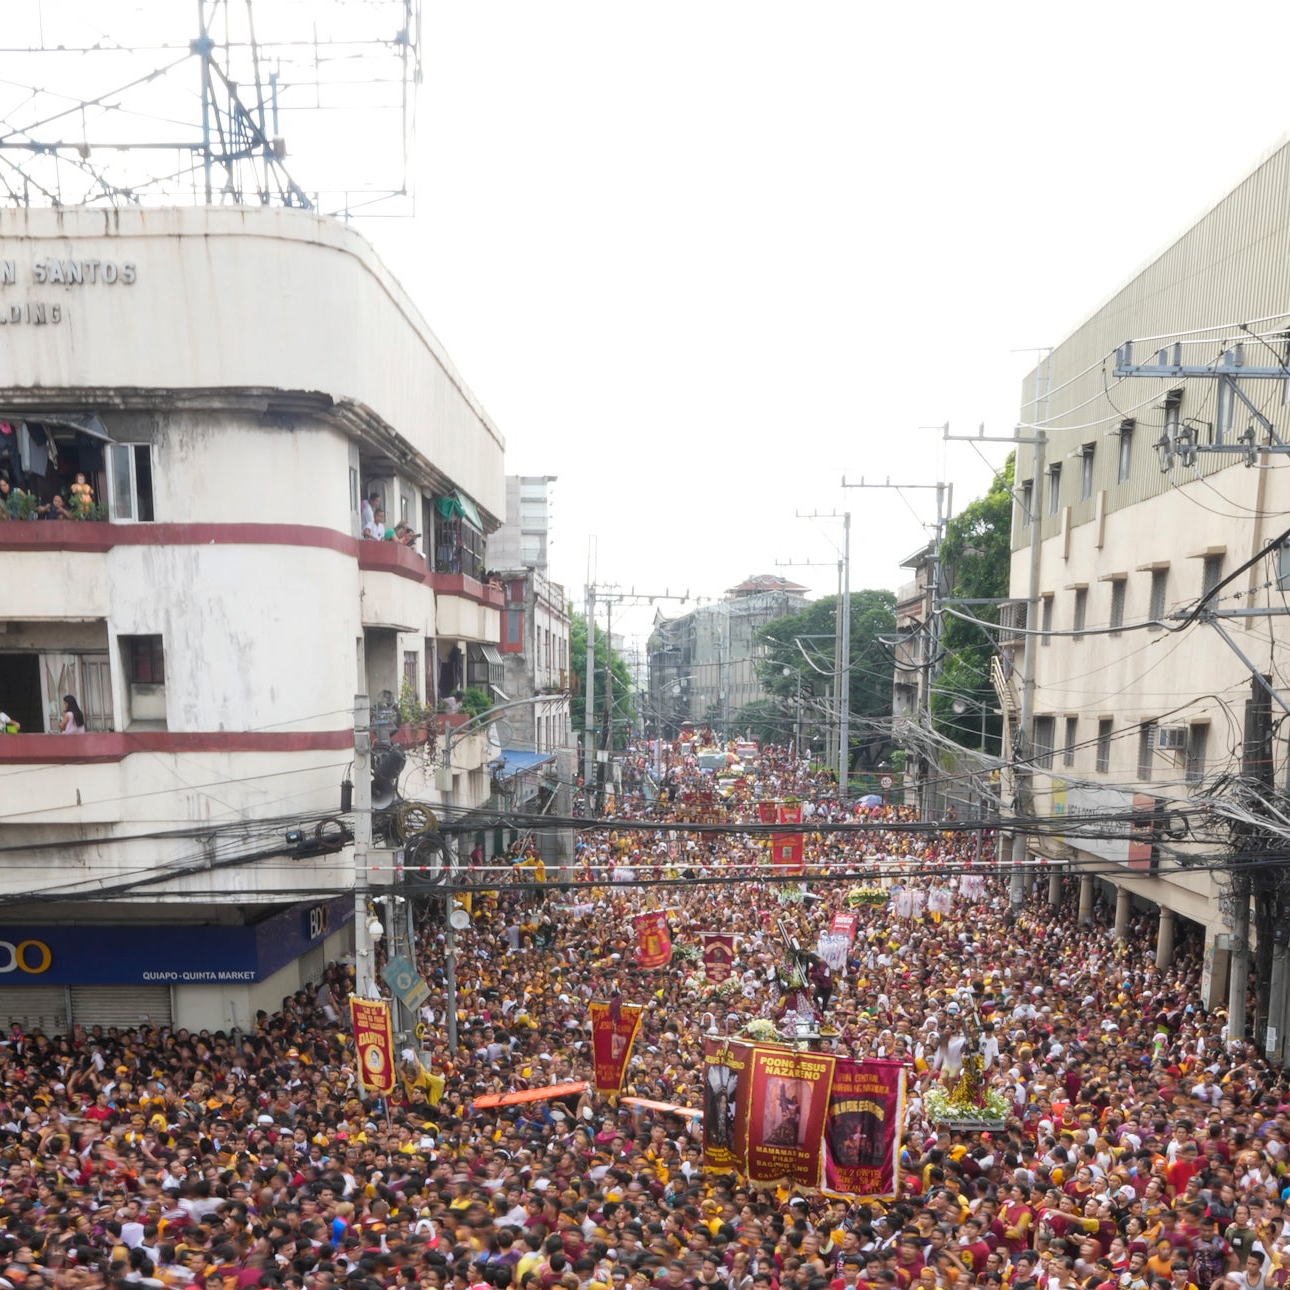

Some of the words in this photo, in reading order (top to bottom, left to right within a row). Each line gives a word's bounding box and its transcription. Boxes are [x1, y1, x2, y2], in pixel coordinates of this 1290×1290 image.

[32, 259, 137, 286] SANTOS
[310, 904, 328, 939] BDO
[142, 971, 178, 980] QUIAPO
[182, 971, 217, 980] QUINTA
[218, 971, 256, 980] MARKET
[760, 1056, 795, 1068] POONG
[765, 1065, 821, 1080] NAZARENO
